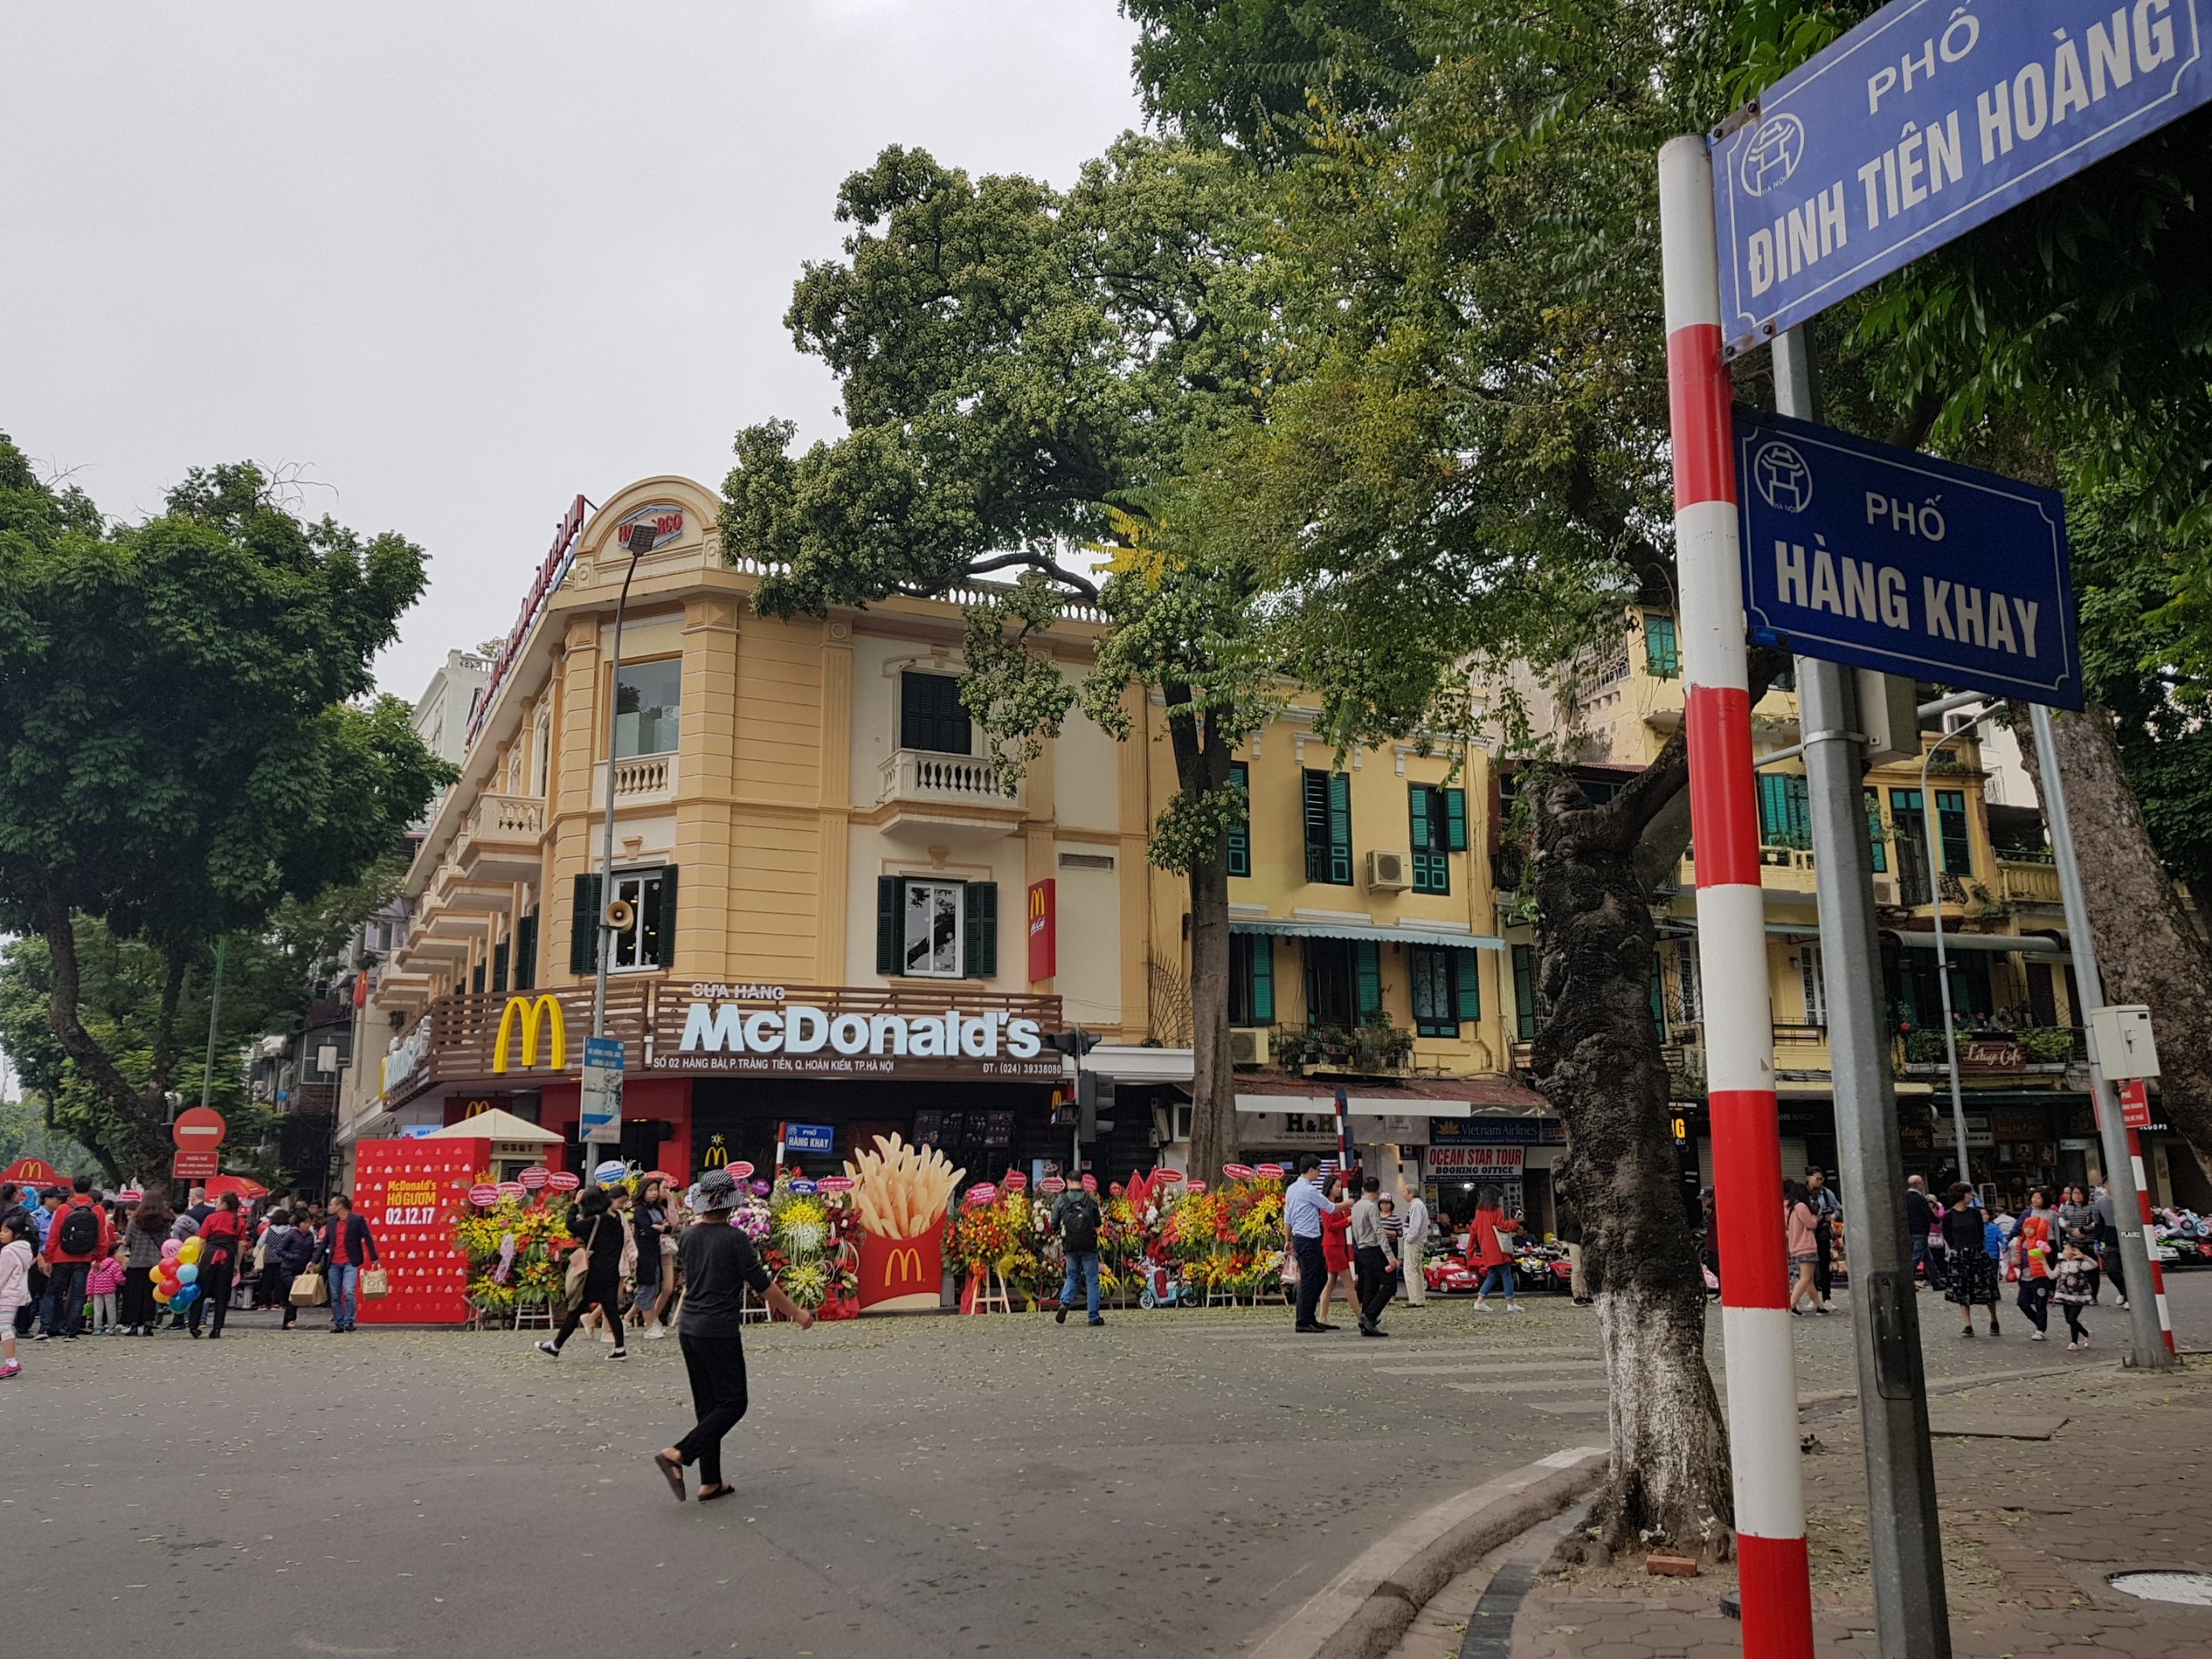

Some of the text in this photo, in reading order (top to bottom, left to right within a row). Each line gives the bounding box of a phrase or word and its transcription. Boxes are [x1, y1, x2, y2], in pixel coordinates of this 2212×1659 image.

[1867, 0, 1980, 115] PHỐ
[1748, 0, 2176, 298] ĐINH TIÊN HOÀNG
[1866, 492, 1947, 542] PHỐ
[1775, 533, 2039, 658] HÀNG KHAY
[734, 982, 785, 1001] HÀNG
[679, 1002, 1041, 1058] McDonald's
[653, 1054, 666, 1068] SỐ
[669, 1058, 679, 1068] 02
[683, 1057, 709, 1069] HÀNG
[880, 1060, 894, 1073] NỘI
[1461, 1123, 1502, 1135] Vietnam
[1503, 1122, 1537, 1136] Airlines
[789, 1135, 830, 1148] HÀNG KHAY
[1430, 1148, 1522, 1166] OCEAN STAR TOUR
[387, 1179, 437, 1192] McDonald's
[385, 1207, 435, 1225] 02.12.17
